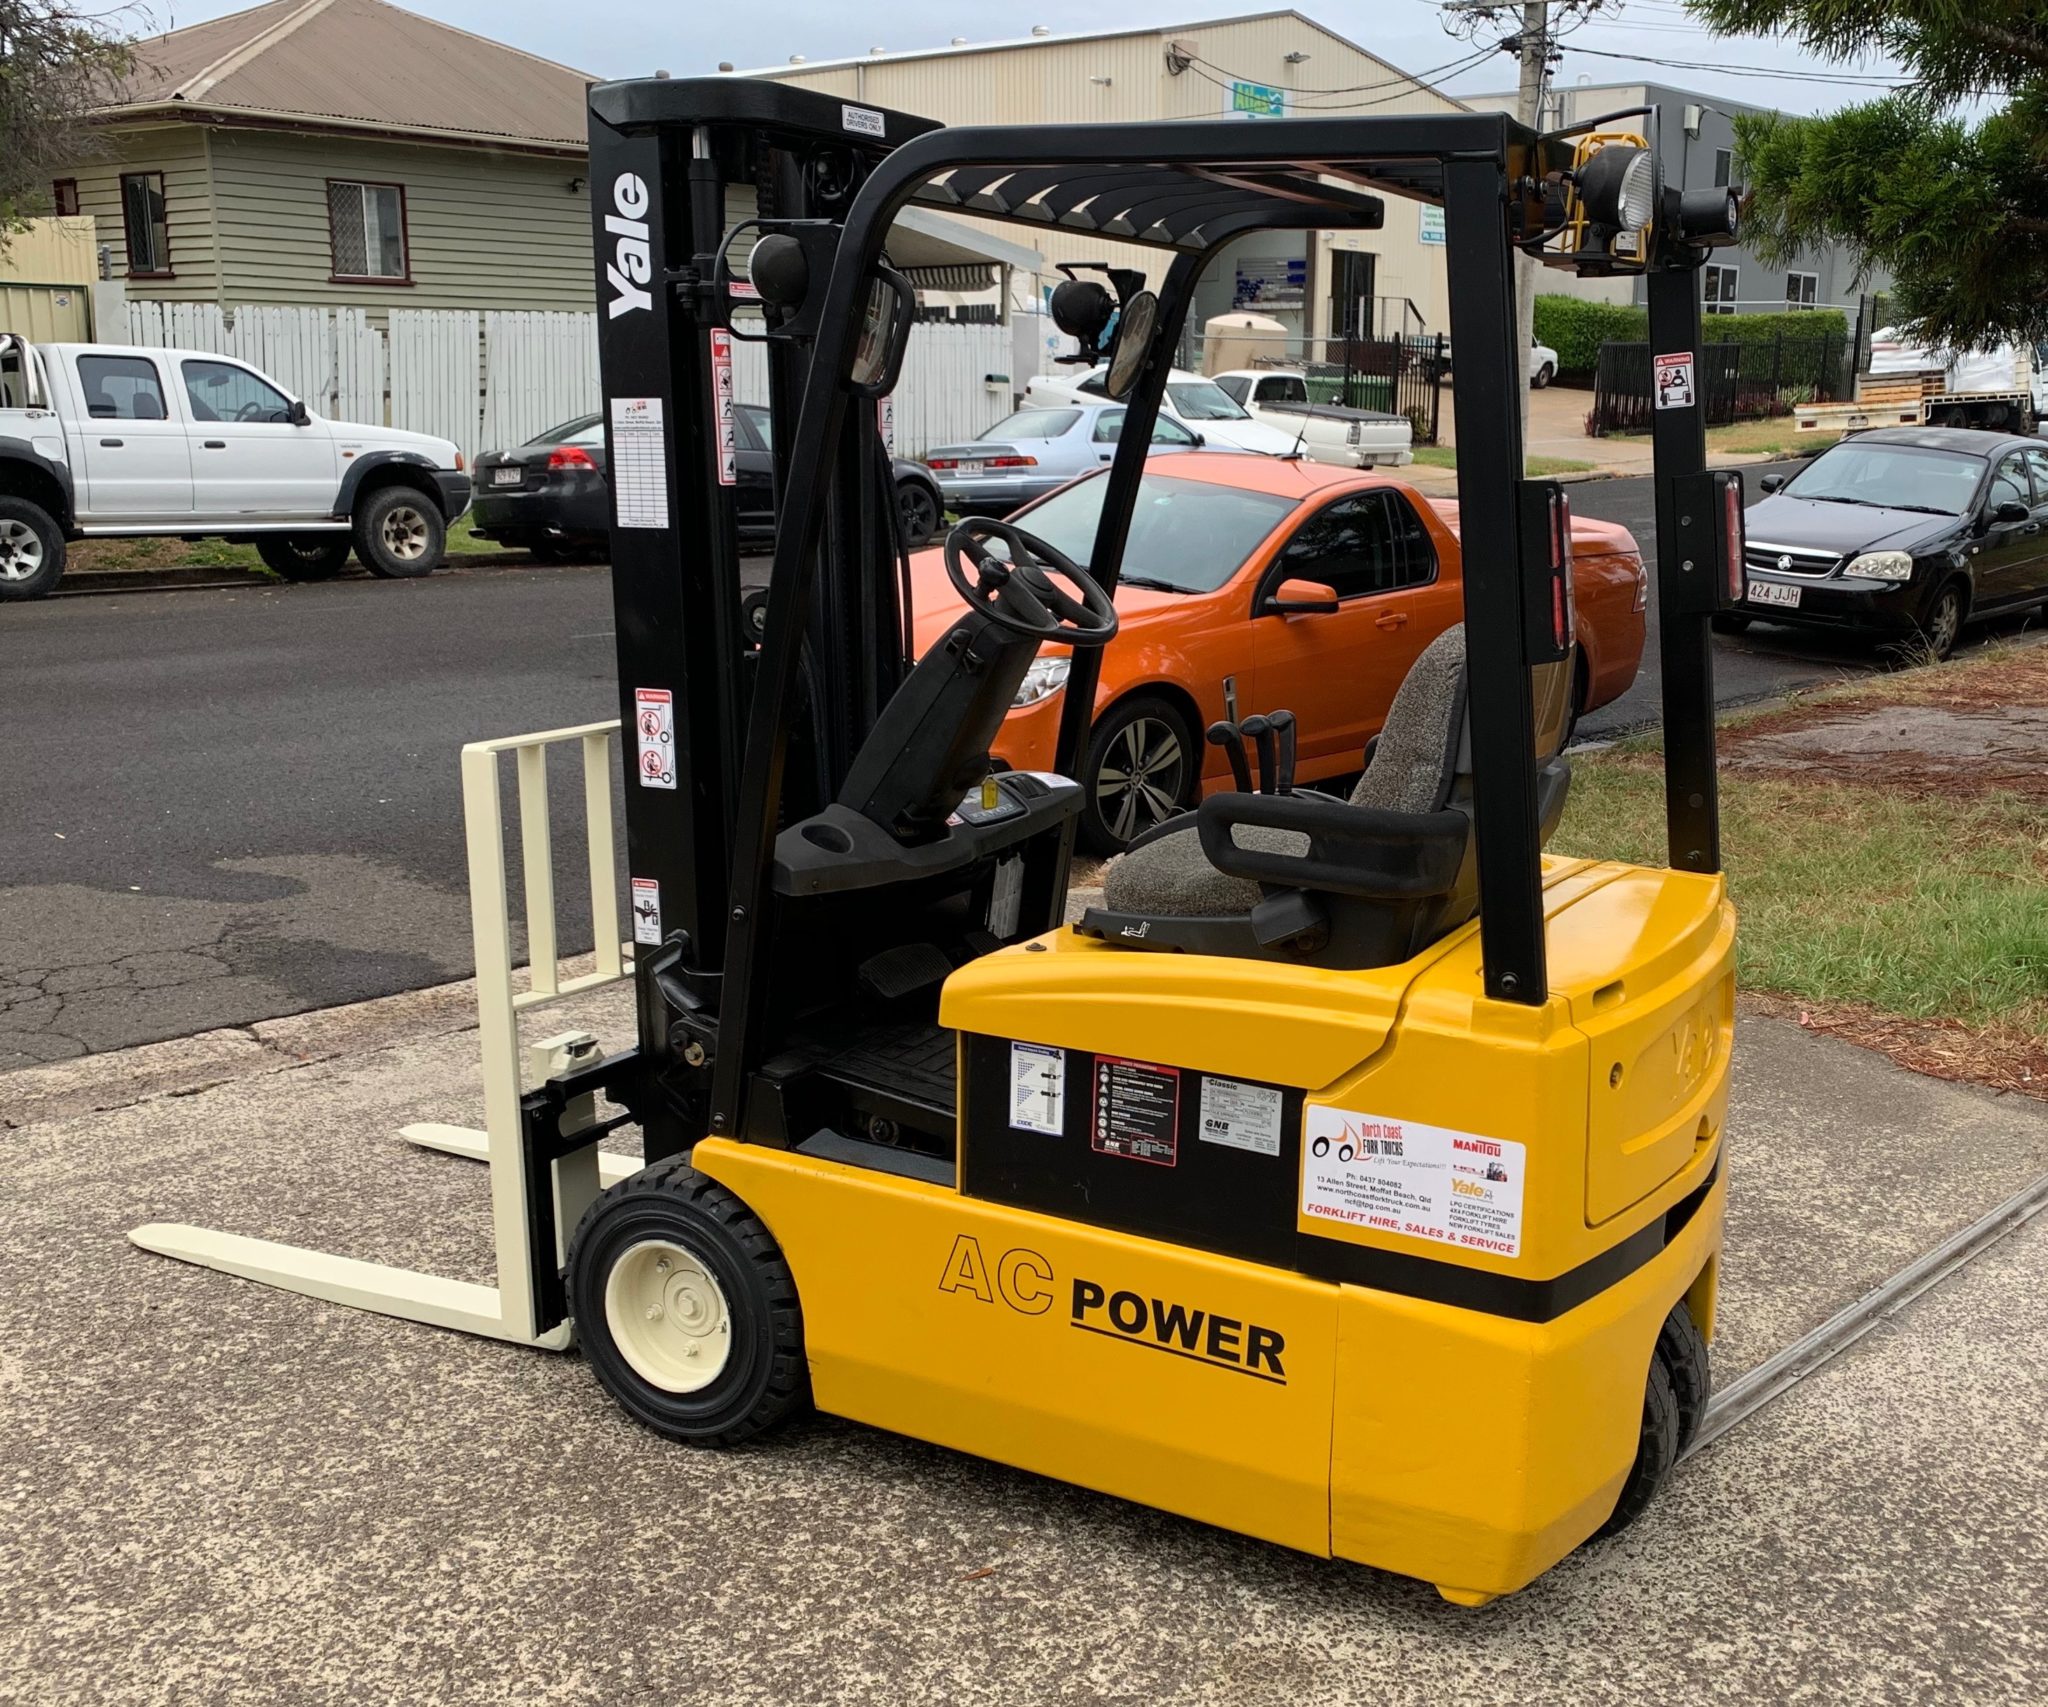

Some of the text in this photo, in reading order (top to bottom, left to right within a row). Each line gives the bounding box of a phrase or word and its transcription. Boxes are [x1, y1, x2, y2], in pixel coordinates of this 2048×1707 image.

[846, 118, 881, 132] DRIVERS ONLY
[848, 112, 880, 124] AUTHORISED
[605, 172, 652, 320] Yale
[1208, 1079, 1238, 1090] Classic
[1205, 1119, 1230, 1130] GNB
[1361, 1123, 1403, 1140] North Coast
[1363, 1139, 1403, 1157] FORK TRUCKS
[1453, 1139, 1501, 1157] MANITOU
[1373, 1157, 1385, 1166] Lift
[1359, 1175, 1376, 1184] 0437
[1326, 1177, 1344, 1186] Allen
[1345, 1181, 1368, 1192] Street,
[1369, 1185, 1392, 1196] Moffat
[1418, 1195, 1432, 1204] Qld
[1451, 1178, 1485, 1198] Yale
[1449, 1200, 1515, 1219] LPG CERTIFICATIONS
[1461, 1210, 1492, 1221] FORKLIFT
[1492, 1217, 1508, 1225] HIRE
[1307, 1203, 1515, 1254] FORKLIFT HIRE, SALES & SERVICE
[1449, 1214, 1501, 1230] FORKLIFT TYRES
[1463, 1225, 1494, 1236] FORKLIFT
[1495, 1231, 1516, 1241] SALES
[938, 1233, 1286, 1377] AC POWER
